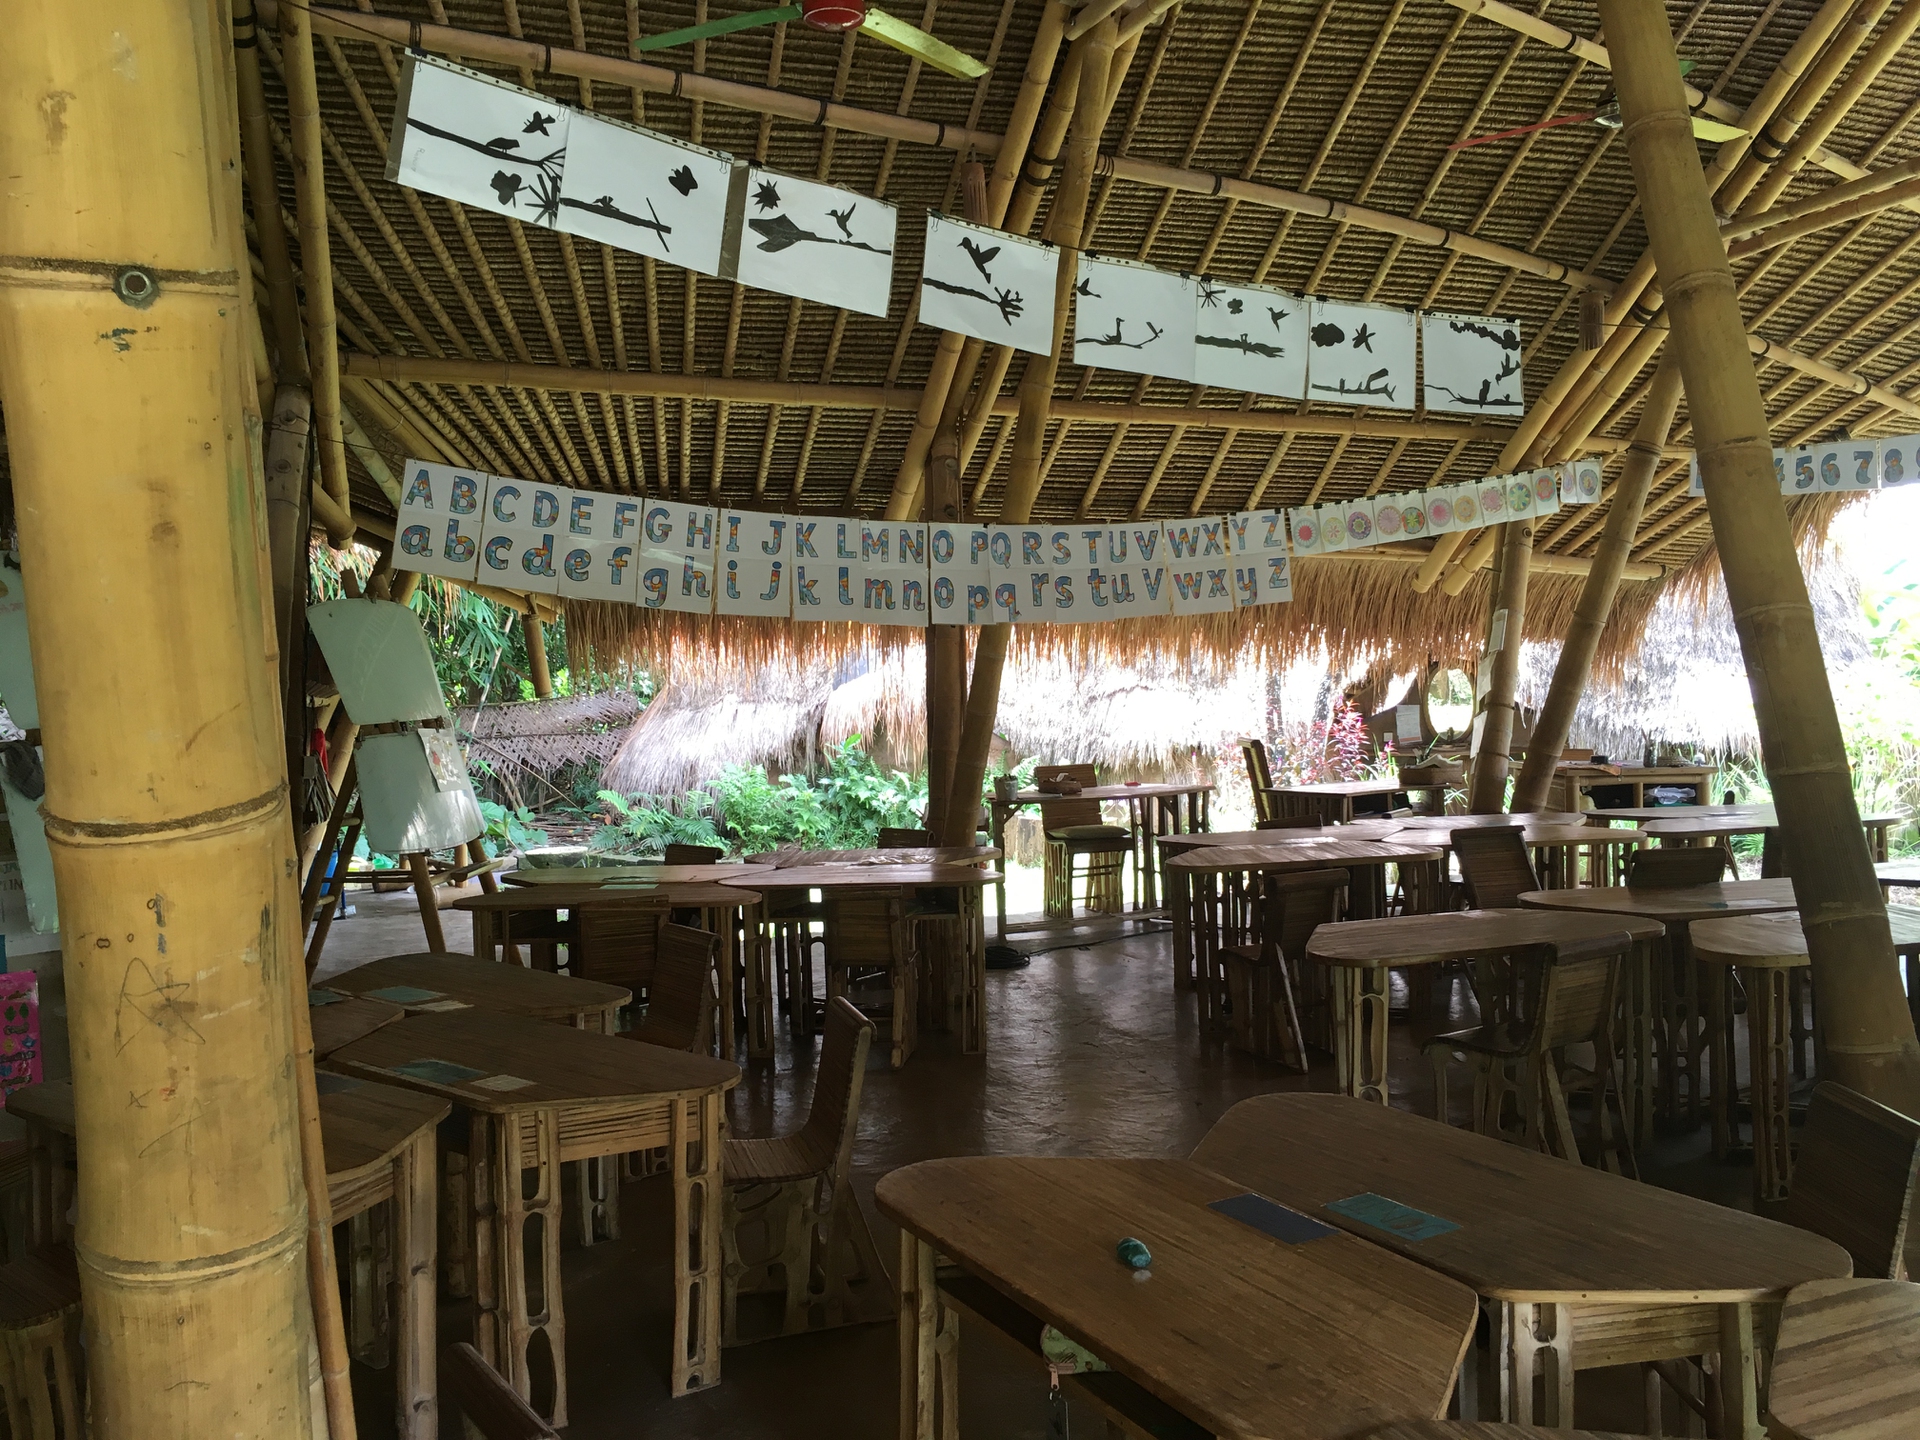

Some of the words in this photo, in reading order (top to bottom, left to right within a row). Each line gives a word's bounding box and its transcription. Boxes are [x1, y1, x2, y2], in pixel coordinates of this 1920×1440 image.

[1796, 455, 1814, 488] 5
[1821, 453, 1840, 486] 6
[1853, 451, 1873, 484] 7
[1884, 449, 1904, 483] 8
[404, 469, 433, 509] A
[450, 475, 478, 514] B
[492, 486, 521, 522] C
[532, 490, 559, 528] D
[569, 496, 594, 534] E
[612, 502, 638, 538] F
[645, 507, 672, 543] G
[686, 512, 712, 549] H
[727, 516, 741, 552] I
[762, 520, 786, 555] J
[796, 522, 818, 558] K
[837, 524, 857, 558] L
[862, 527, 889, 562] M
[900, 529, 924, 563] N
[932, 529, 954, 564] O
[971, 531, 988, 564] P
[991, 532, 1011, 568] Q
[1022, 532, 1044, 564] R
[1052, 532, 1071, 565] S
[1082, 531, 1102, 564] T
[1109, 530, 1126, 563] U
[1134, 530, 1158, 561] V
[1167, 527, 1200, 558] W
[1201, 523, 1223, 555] X
[1230, 518, 1249, 550] Y
[1262, 515, 1282, 548] Z
[401, 524, 432, 558] a
[444, 518, 475, 562] b
[522, 533, 556, 577] d
[563, 549, 592, 581] e
[608, 547, 632, 585] f
[643, 568, 669, 607] g
[682, 556, 710, 598] h
[726, 560, 740, 599] i
[760, 561, 782, 600] j
[798, 566, 820, 606] k
[864, 578, 896, 609] m
[902, 580, 925, 611] n
[968, 584, 990, 623] p
[995, 584, 1022, 622] q
[1031, 572, 1048, 606] r
[1088, 568, 1108, 607] t
[1112, 573, 1135, 602] u
[1236, 568, 1258, 605] y
